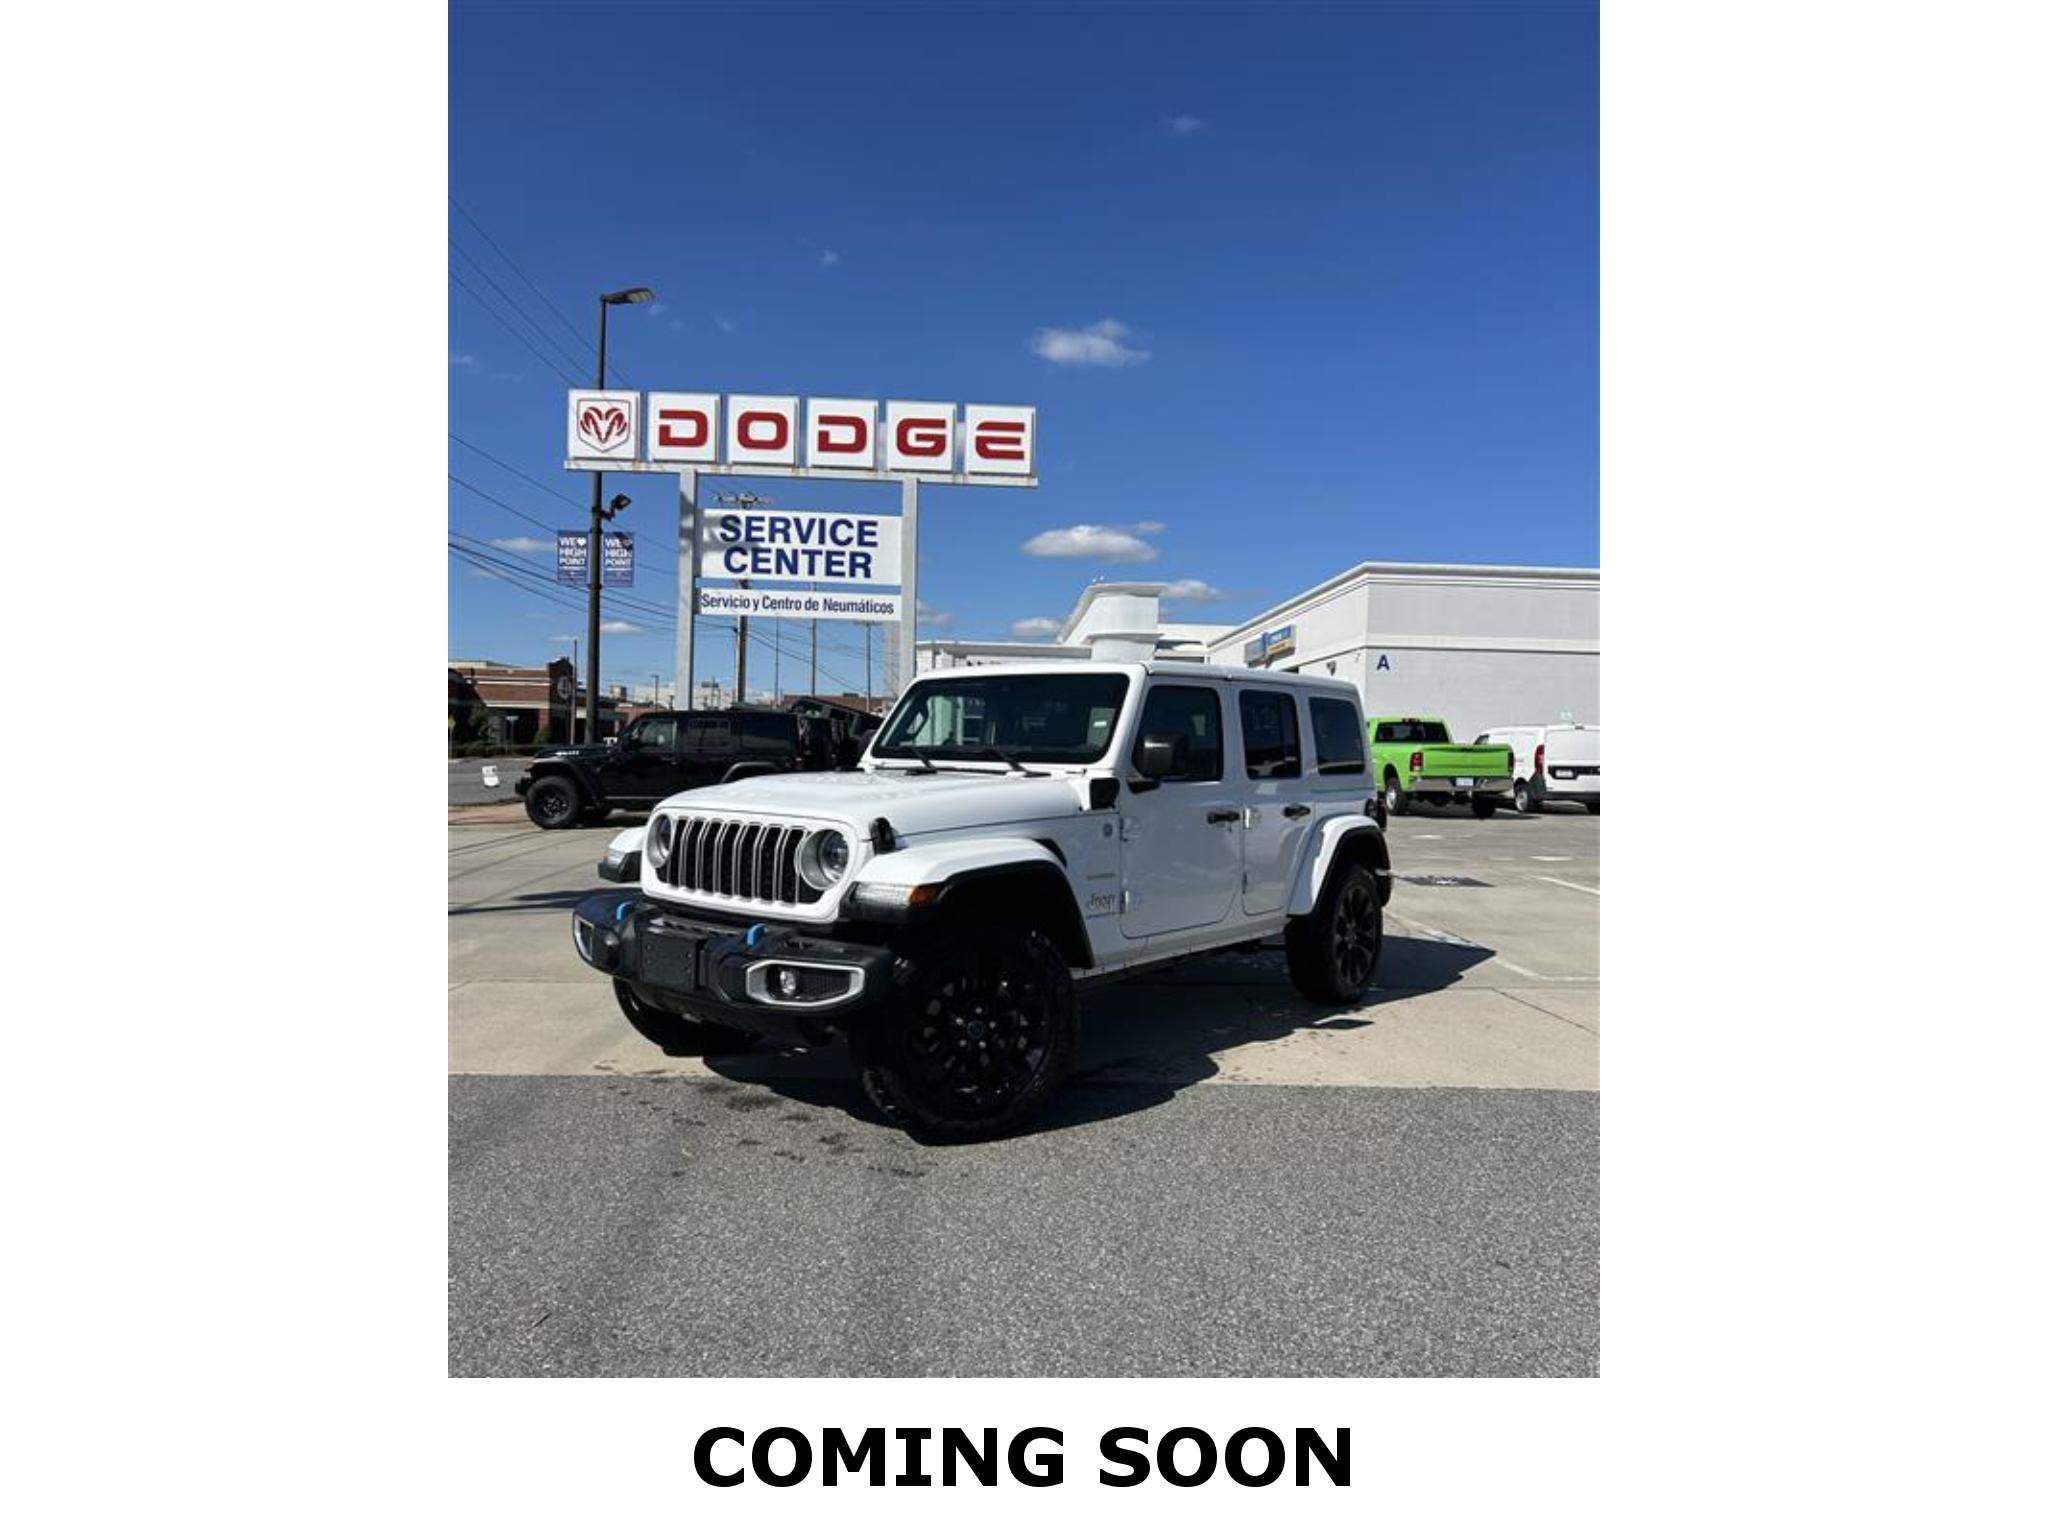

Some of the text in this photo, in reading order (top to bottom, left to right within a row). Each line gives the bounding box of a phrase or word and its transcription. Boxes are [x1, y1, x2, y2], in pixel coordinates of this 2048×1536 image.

[658, 409, 1025, 460] DODGE
[720, 515, 878, 547] SERVICE
[559, 548, 587, 557] HIGH
[605, 549, 632, 558] HIGH
[559, 558, 585, 566] POINT
[605, 558, 631, 567] POINT
[724, 547, 872, 578] CENTER
[701, 594, 894, 614] Servicio y Centro de Neumáticos
[1376, 654, 1390, 671] A
